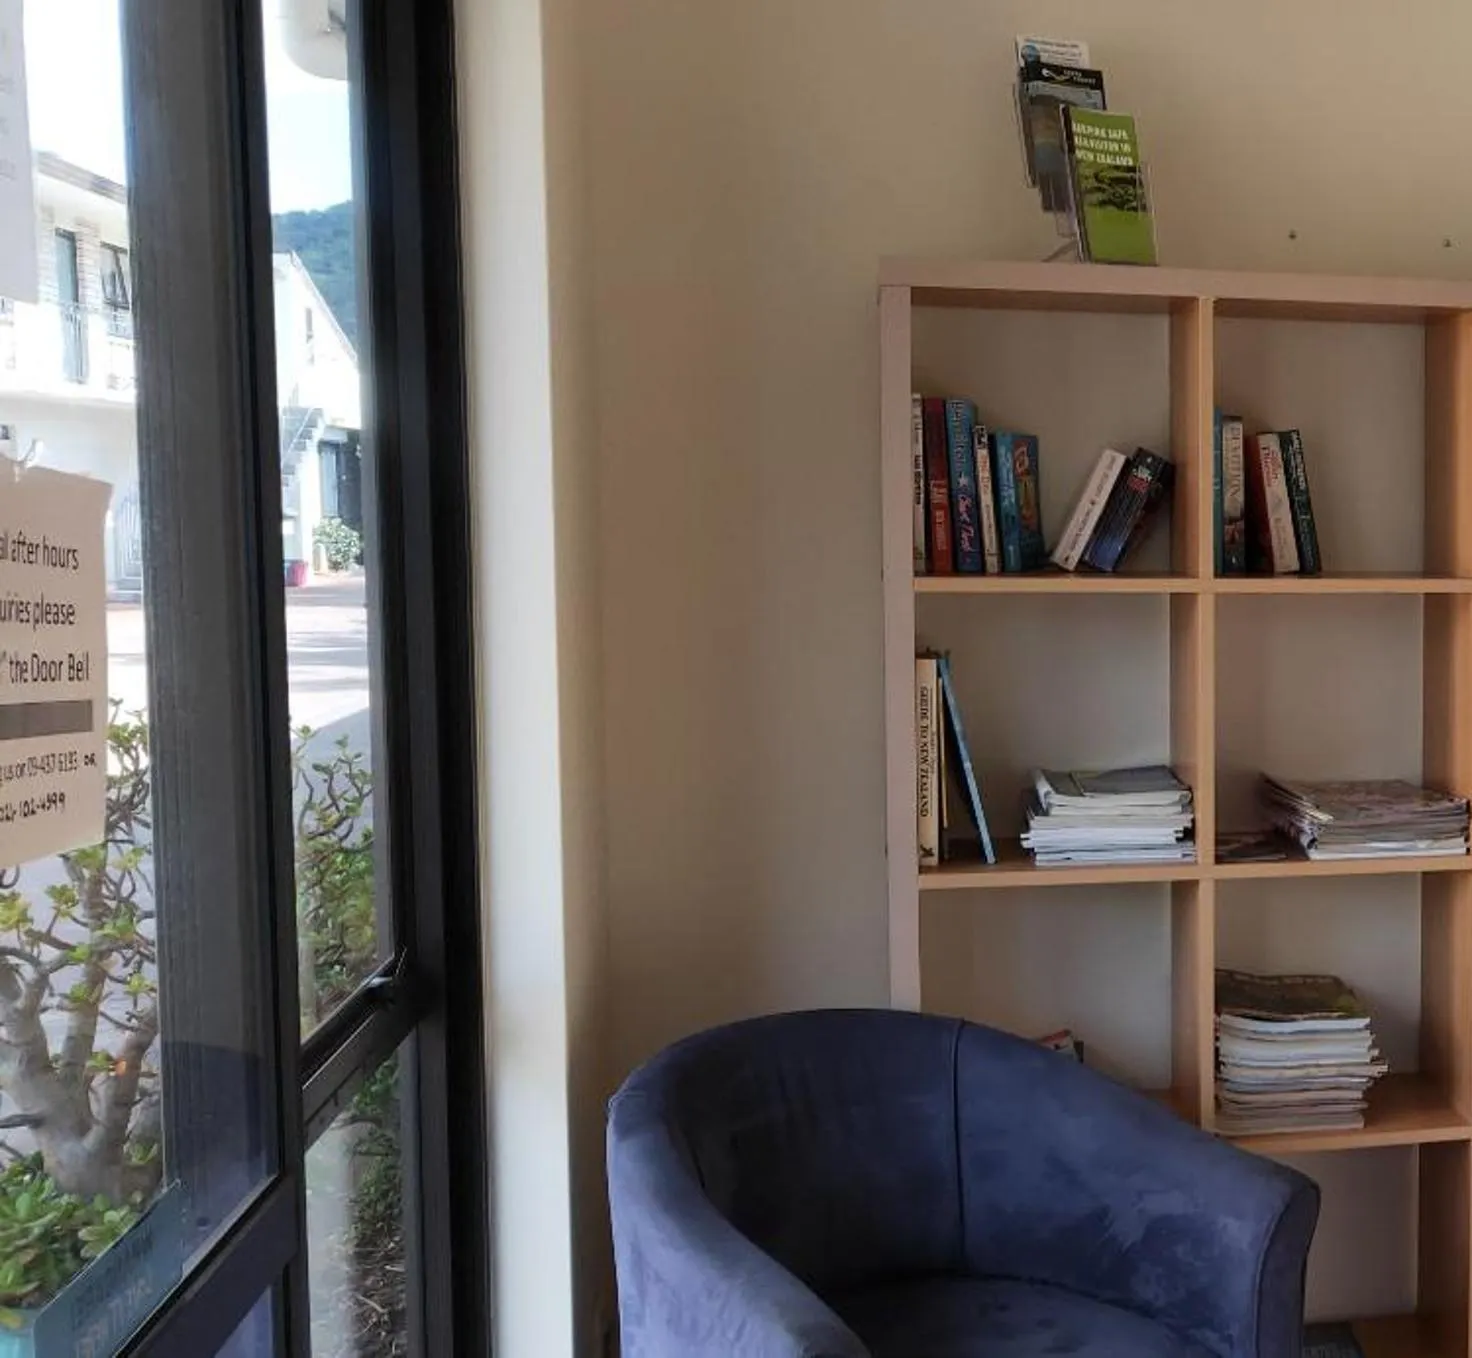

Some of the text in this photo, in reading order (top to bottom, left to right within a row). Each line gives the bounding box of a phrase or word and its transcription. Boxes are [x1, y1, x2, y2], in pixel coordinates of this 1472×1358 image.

[11, 530, 40, 565] after
[43, 535, 80, 571] hours
[33, 591, 76, 633] please
[9, 651, 90, 684] the Door Bell
[919, 687, 929, 818] GUIDE TO NEW ZEALAND
